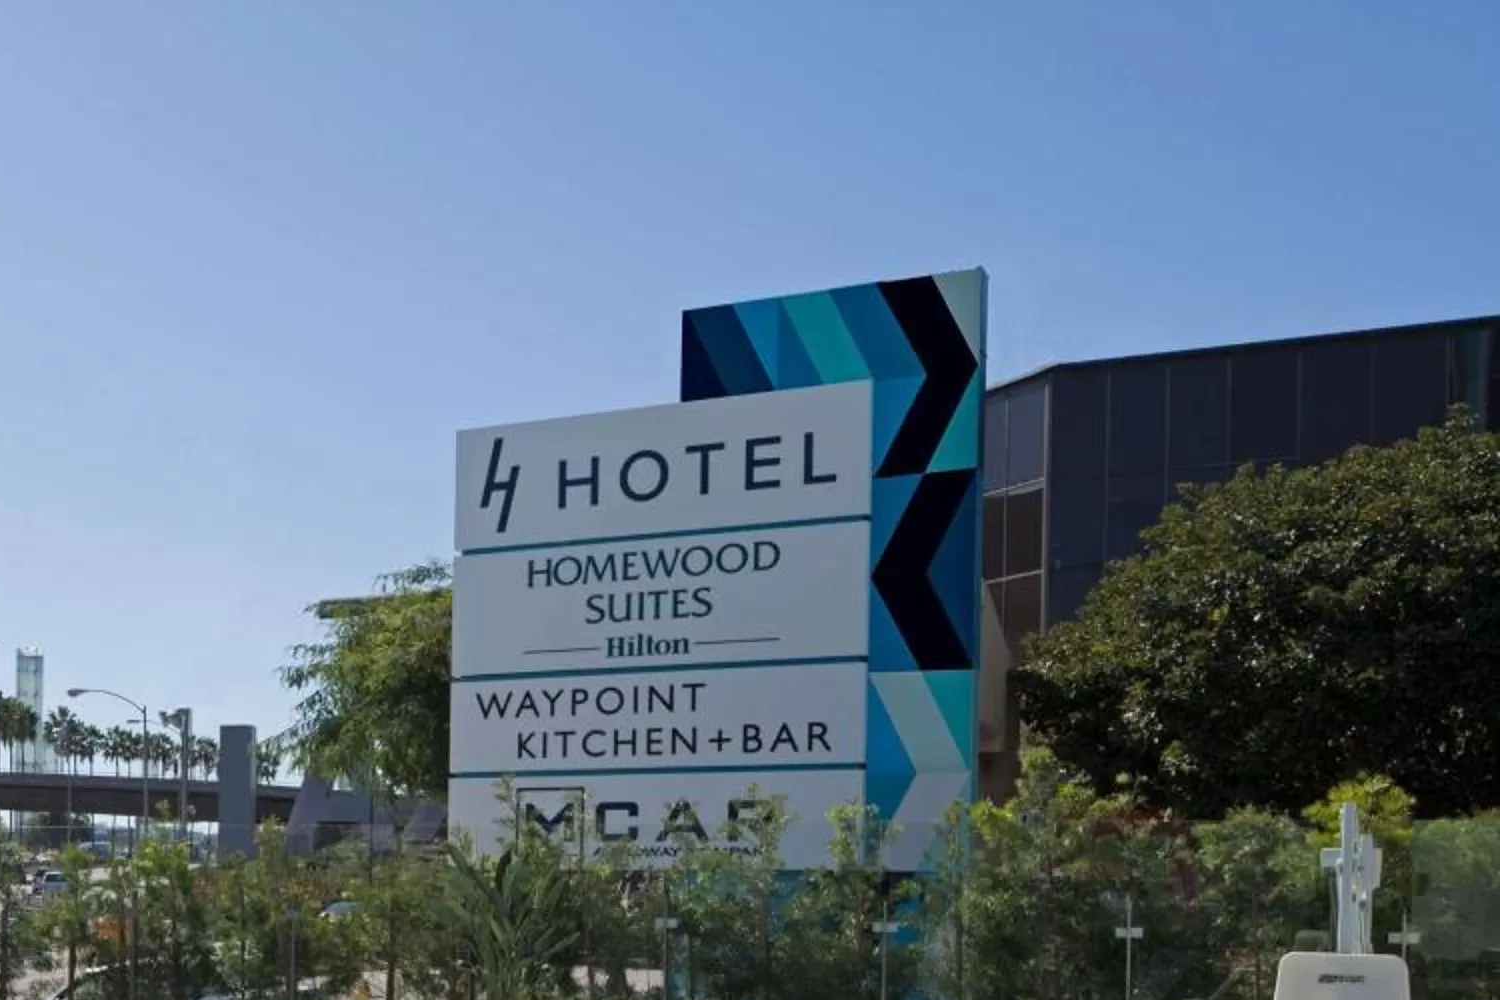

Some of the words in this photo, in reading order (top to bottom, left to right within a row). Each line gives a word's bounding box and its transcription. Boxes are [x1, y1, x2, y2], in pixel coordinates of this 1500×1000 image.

[558, 432, 837, 509] HOTEL
[527, 541, 781, 588] HOMEWOOD
[585, 587, 713, 624] SUITES
[605, 633, 690, 658] Hilton
[476, 683, 707, 719] WAYPOINT
[517, 721, 832, 760] KITCHEN+BAR
